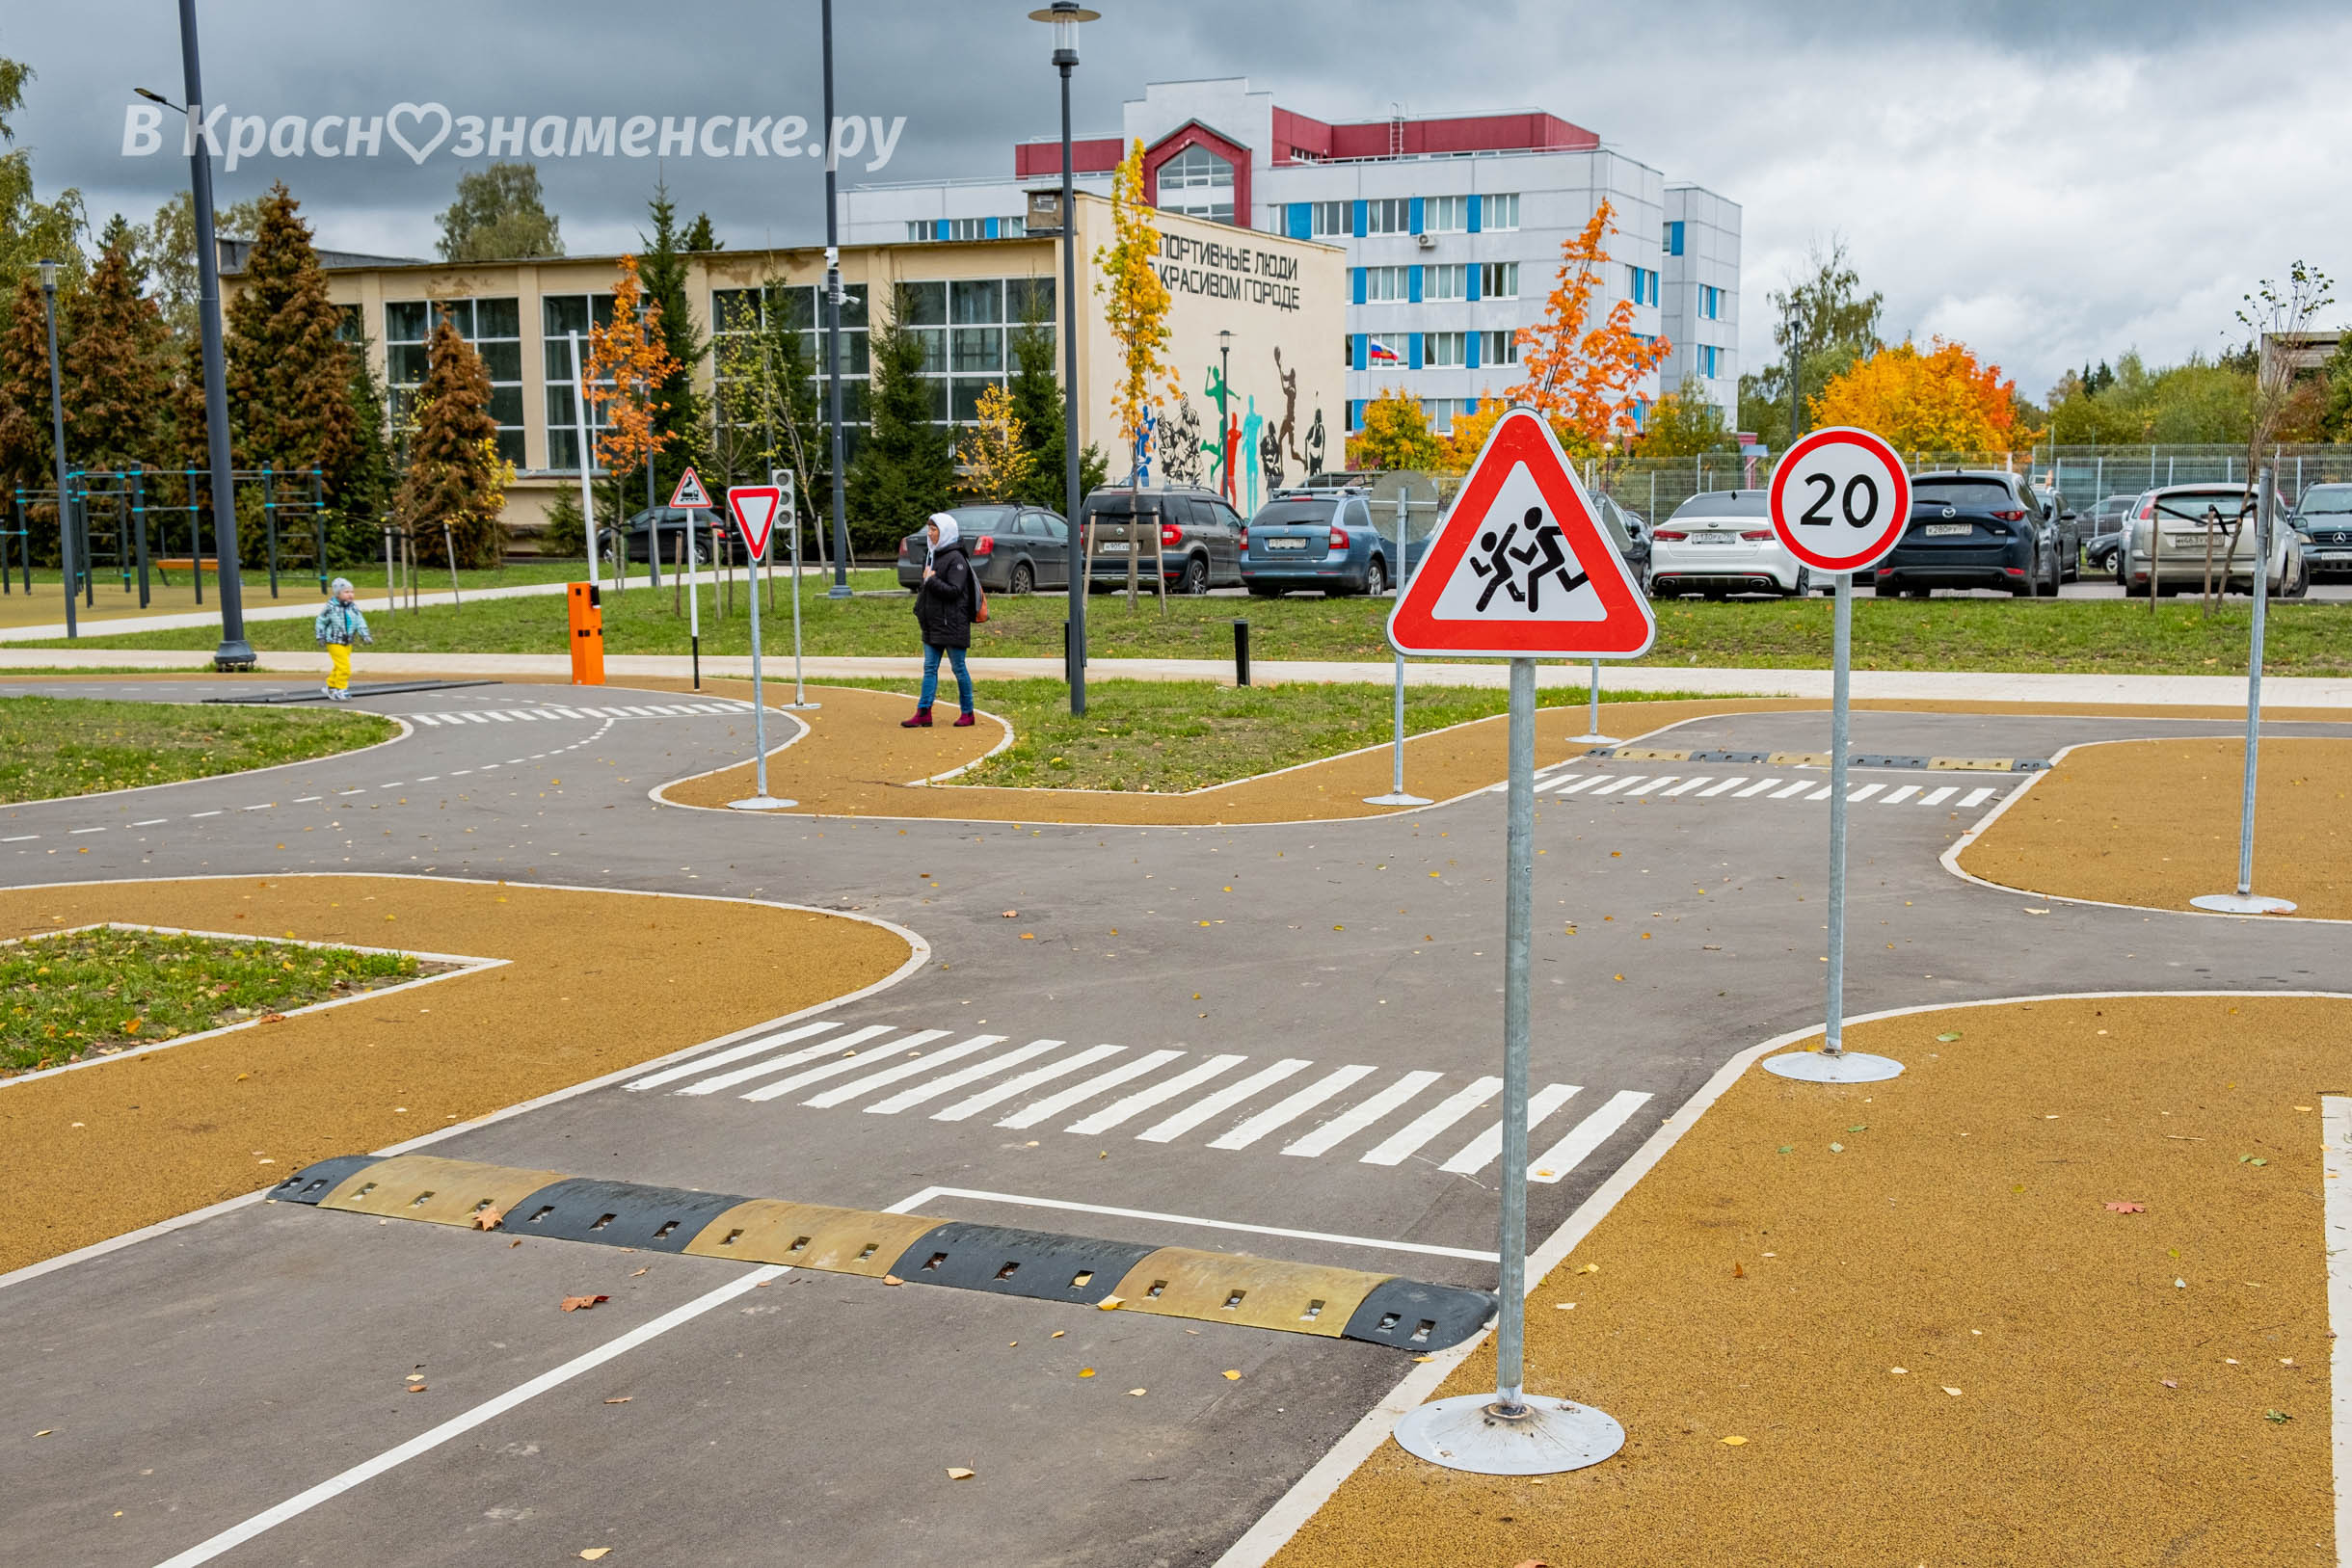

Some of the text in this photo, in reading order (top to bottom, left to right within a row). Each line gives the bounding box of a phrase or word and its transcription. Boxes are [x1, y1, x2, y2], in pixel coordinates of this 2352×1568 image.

[1158, 232, 1298, 281] ПОРТИВНЫЕ ЛЮДИ
[1160, 263, 1300, 313] КРАСИВОМ ГОРОДЕ
[1800, 472, 1879, 528] 20
